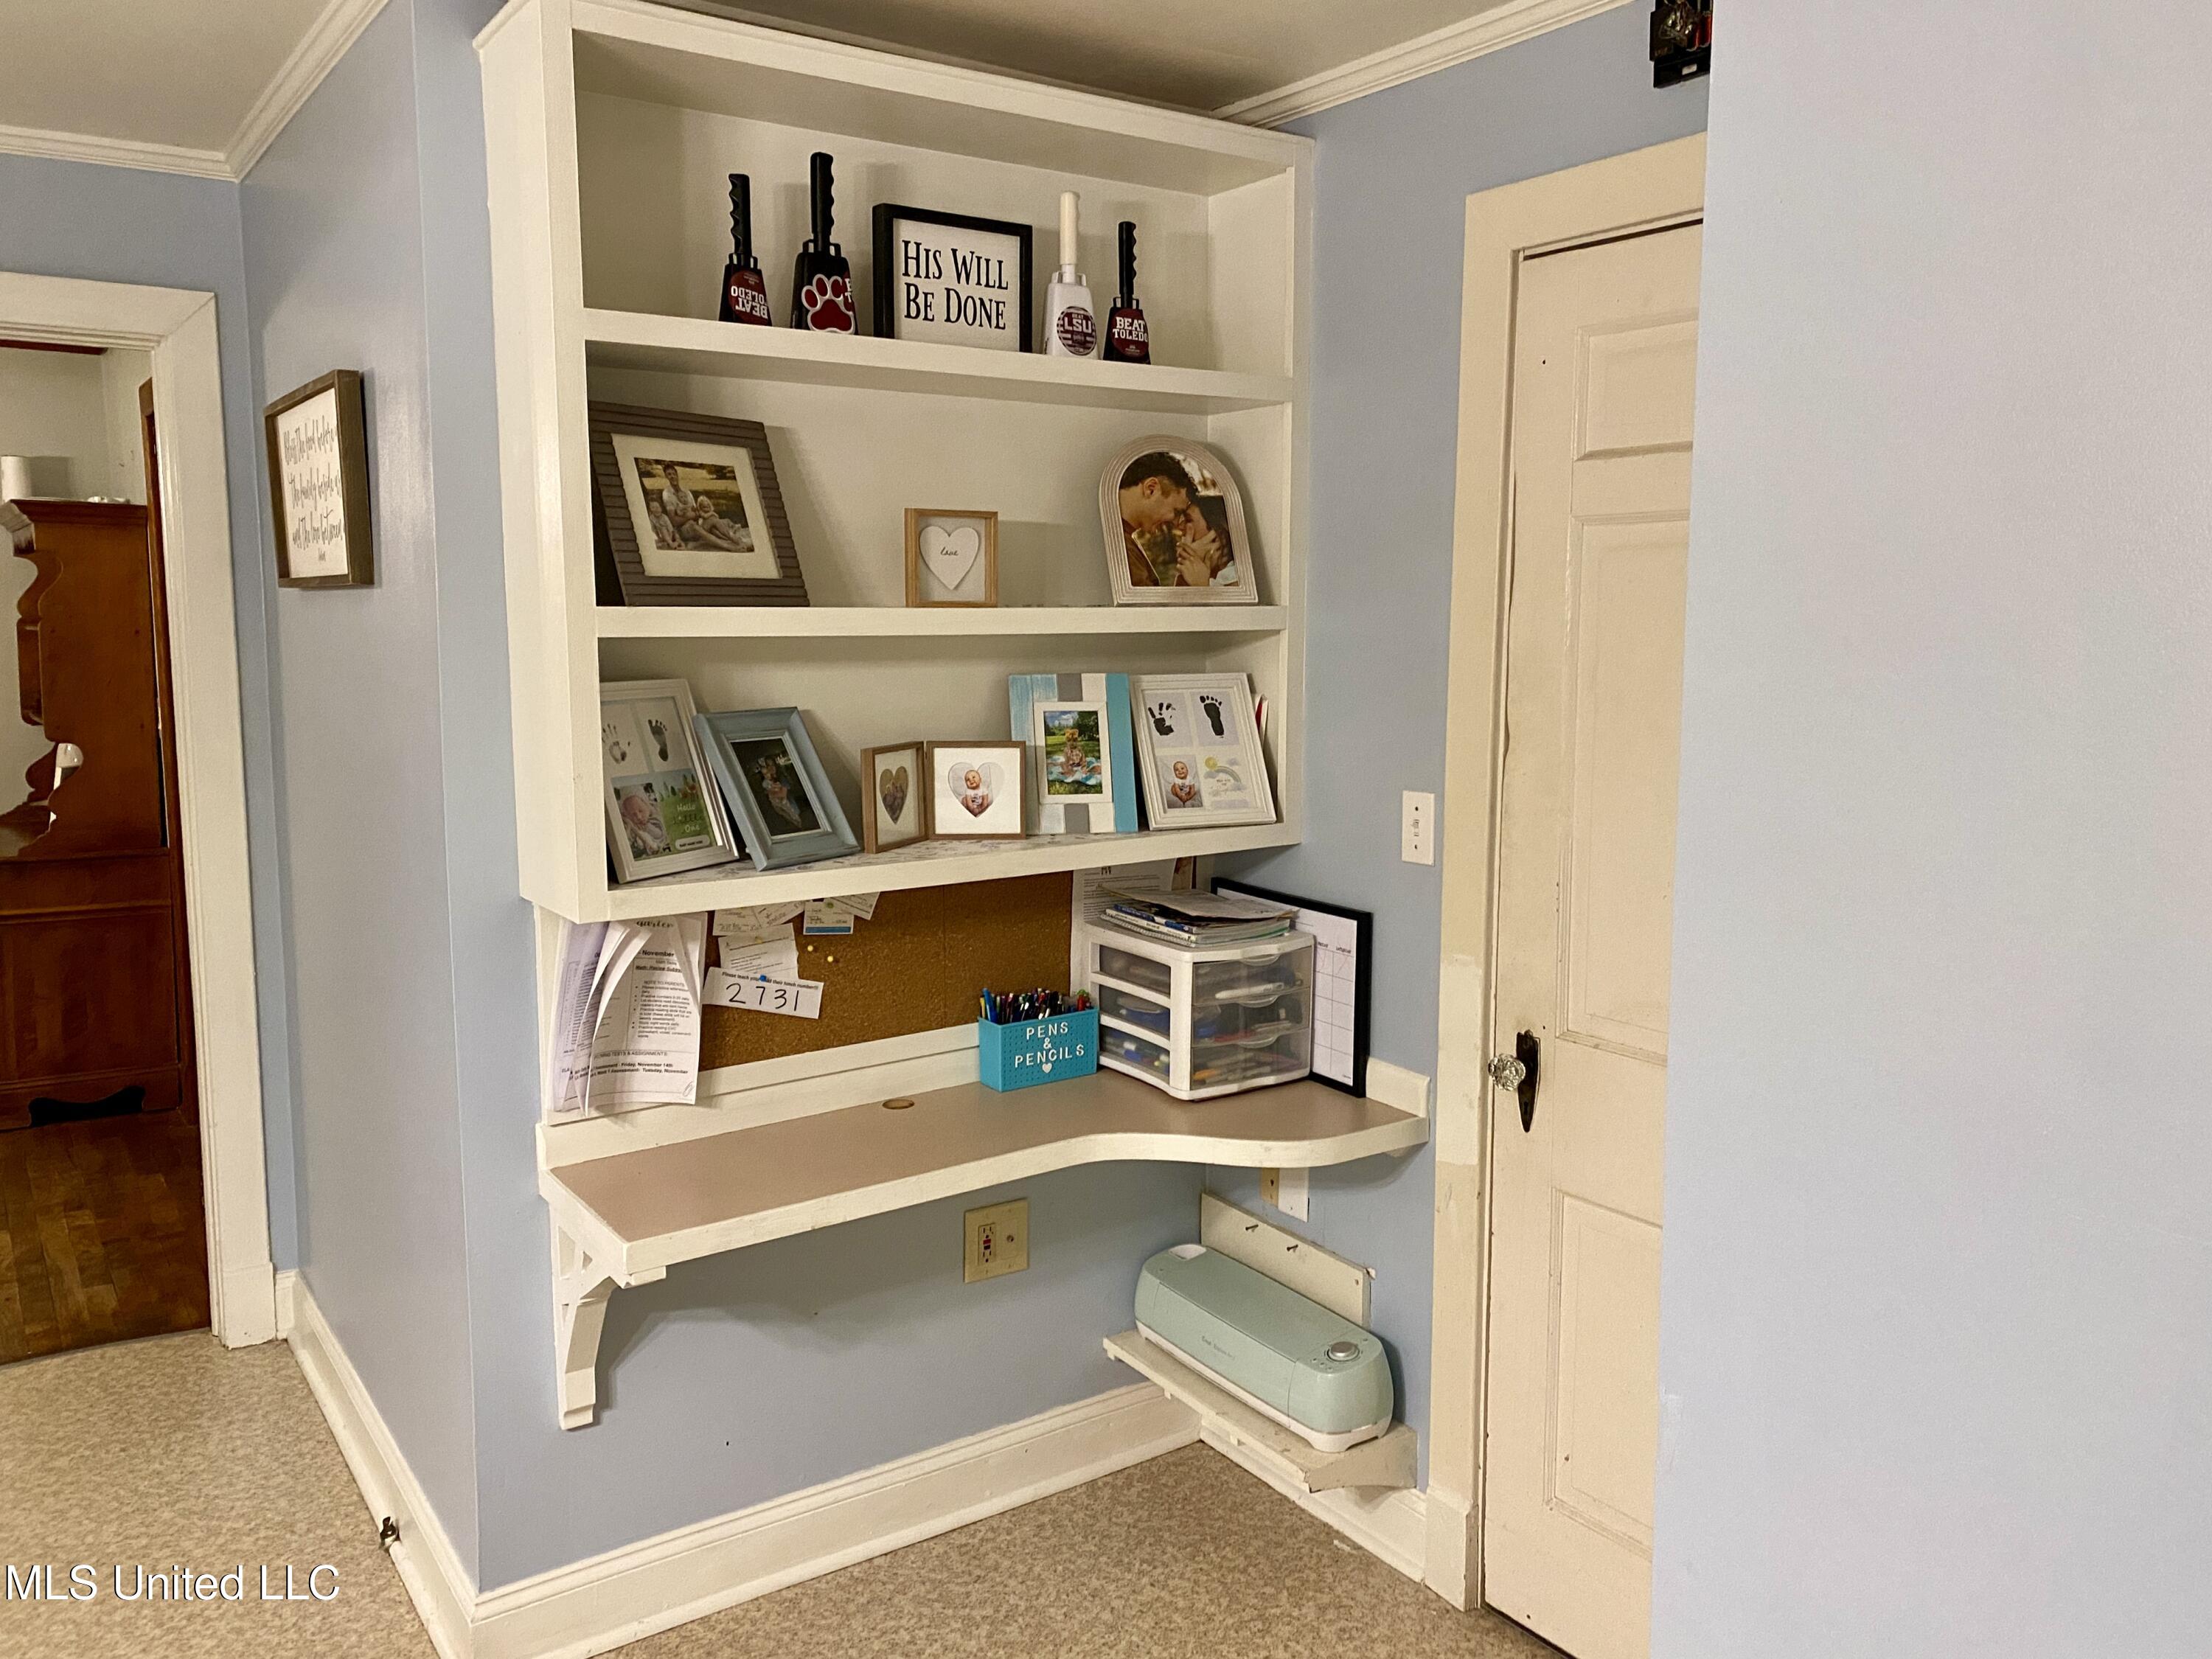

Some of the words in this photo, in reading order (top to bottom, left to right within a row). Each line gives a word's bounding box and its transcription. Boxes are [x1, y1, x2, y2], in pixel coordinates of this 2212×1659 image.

[735, 297, 768, 319] BEAT
[1064, 317, 1092, 333] LSU
[1116, 316, 1145, 332] BEAT
[1113, 329, 1148, 342] TOLEDO
[940, 546, 959, 556] love
[1026, 1021, 1068, 1040] PENS
[1043, 1037, 1052, 1049] &
[1015, 1043, 1085, 1068] PENCILS
